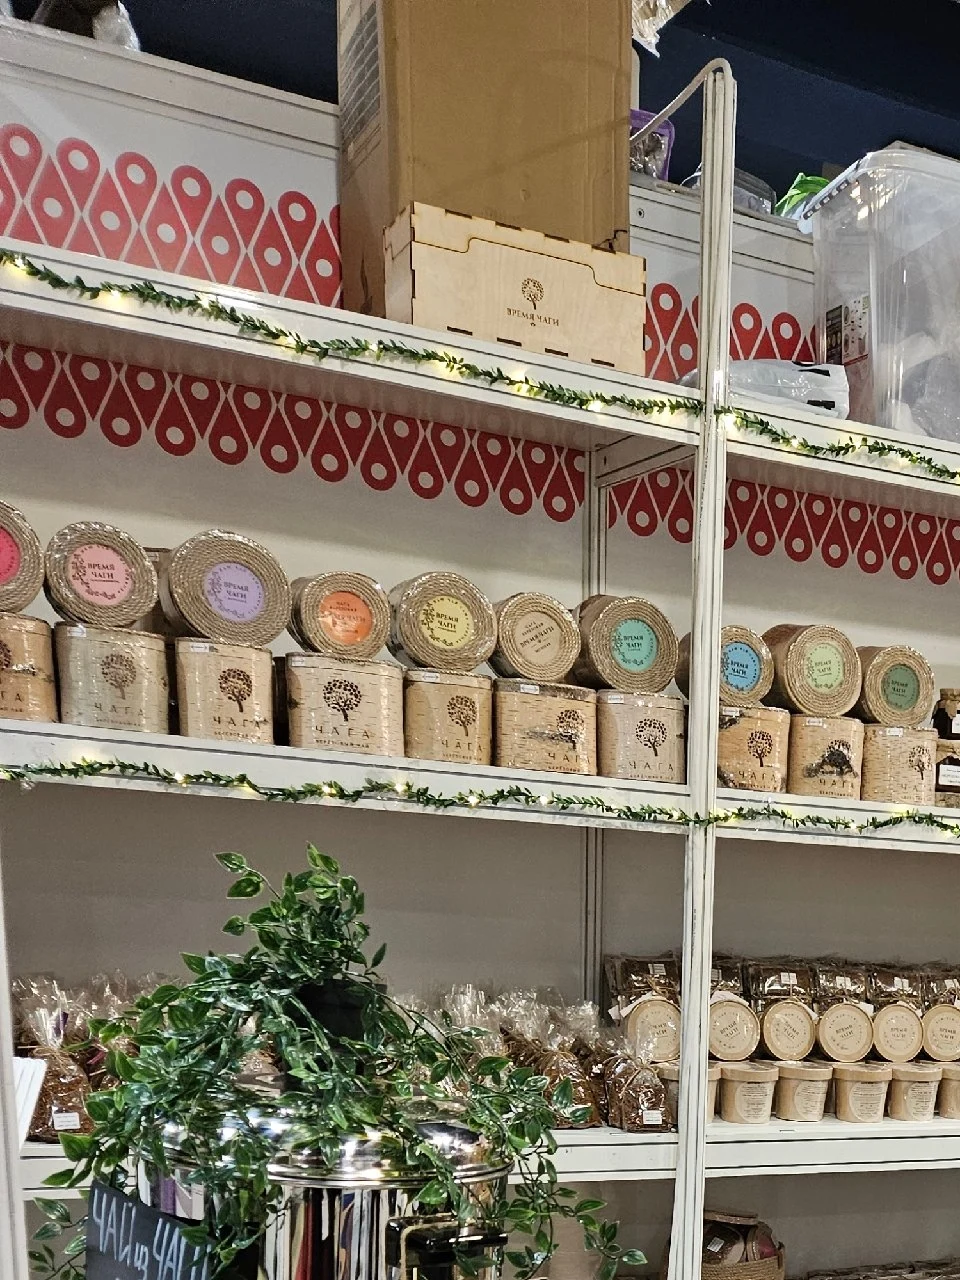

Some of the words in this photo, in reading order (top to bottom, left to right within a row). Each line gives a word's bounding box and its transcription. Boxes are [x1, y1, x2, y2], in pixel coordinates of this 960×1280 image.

[213, 716, 261, 729] ЧАГА
[315, 724, 370, 739] ЧАГА
[441, 738, 483, 752] ЧАГА
[548, 752, 591, 765] ЧАГА
[628, 761, 674, 773] ЧАГА
[91, 1188, 137, 1265] ЧАЙ
